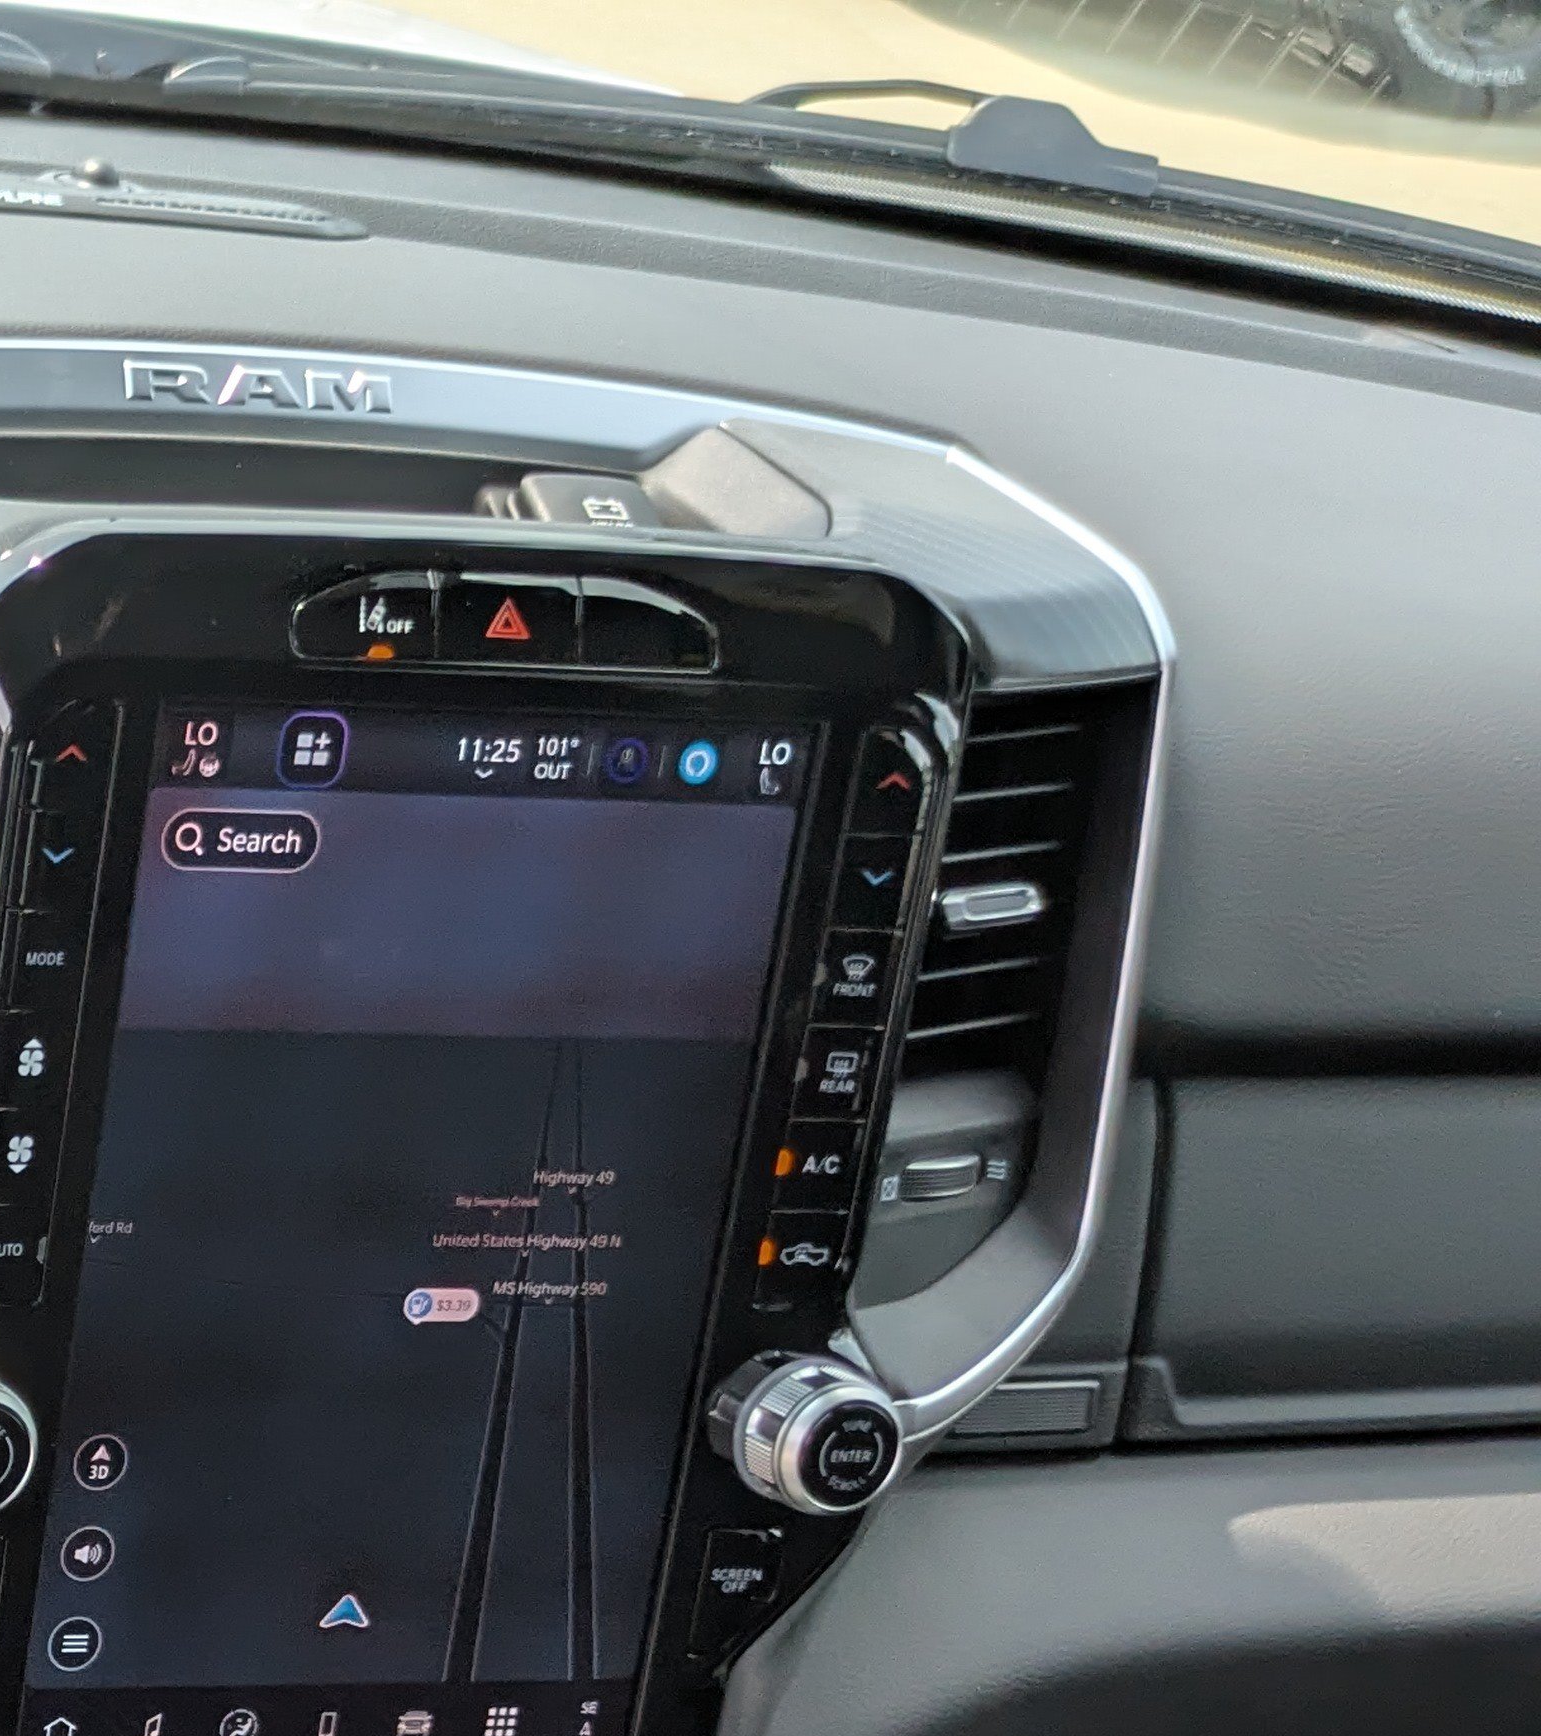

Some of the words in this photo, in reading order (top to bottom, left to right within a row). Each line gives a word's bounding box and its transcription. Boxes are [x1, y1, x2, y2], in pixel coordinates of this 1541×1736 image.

[124, 359, 394, 413] RAM
[386, 619, 414, 634] OFF
[185, 721, 218, 746] LO
[458, 737, 522, 763] 11:25
[537, 737, 580, 757] 101°
[759, 739, 792, 766] LO
[534, 762, 572, 780] OUT
[217, 825, 301, 855] Search
[25, 952, 65, 966] MODE
[833, 983, 875, 997] FRONT
[802, 1154, 840, 1175] A/C
[533, 1169, 593, 1187] Highway
[116, 1222, 133, 1234] Rd
[433, 1233, 480, 1248] United
[482, 1234, 525, 1248] States
[526, 1234, 587, 1251] Highway
[492, 1281, 516, 1295] MS
[518, 1281, 578, 1298] Highway
[88, 1464, 110, 1480] 3D
[710, 1568, 764, 1583] SCREEN
[580, 1702, 598, 1715] SE
